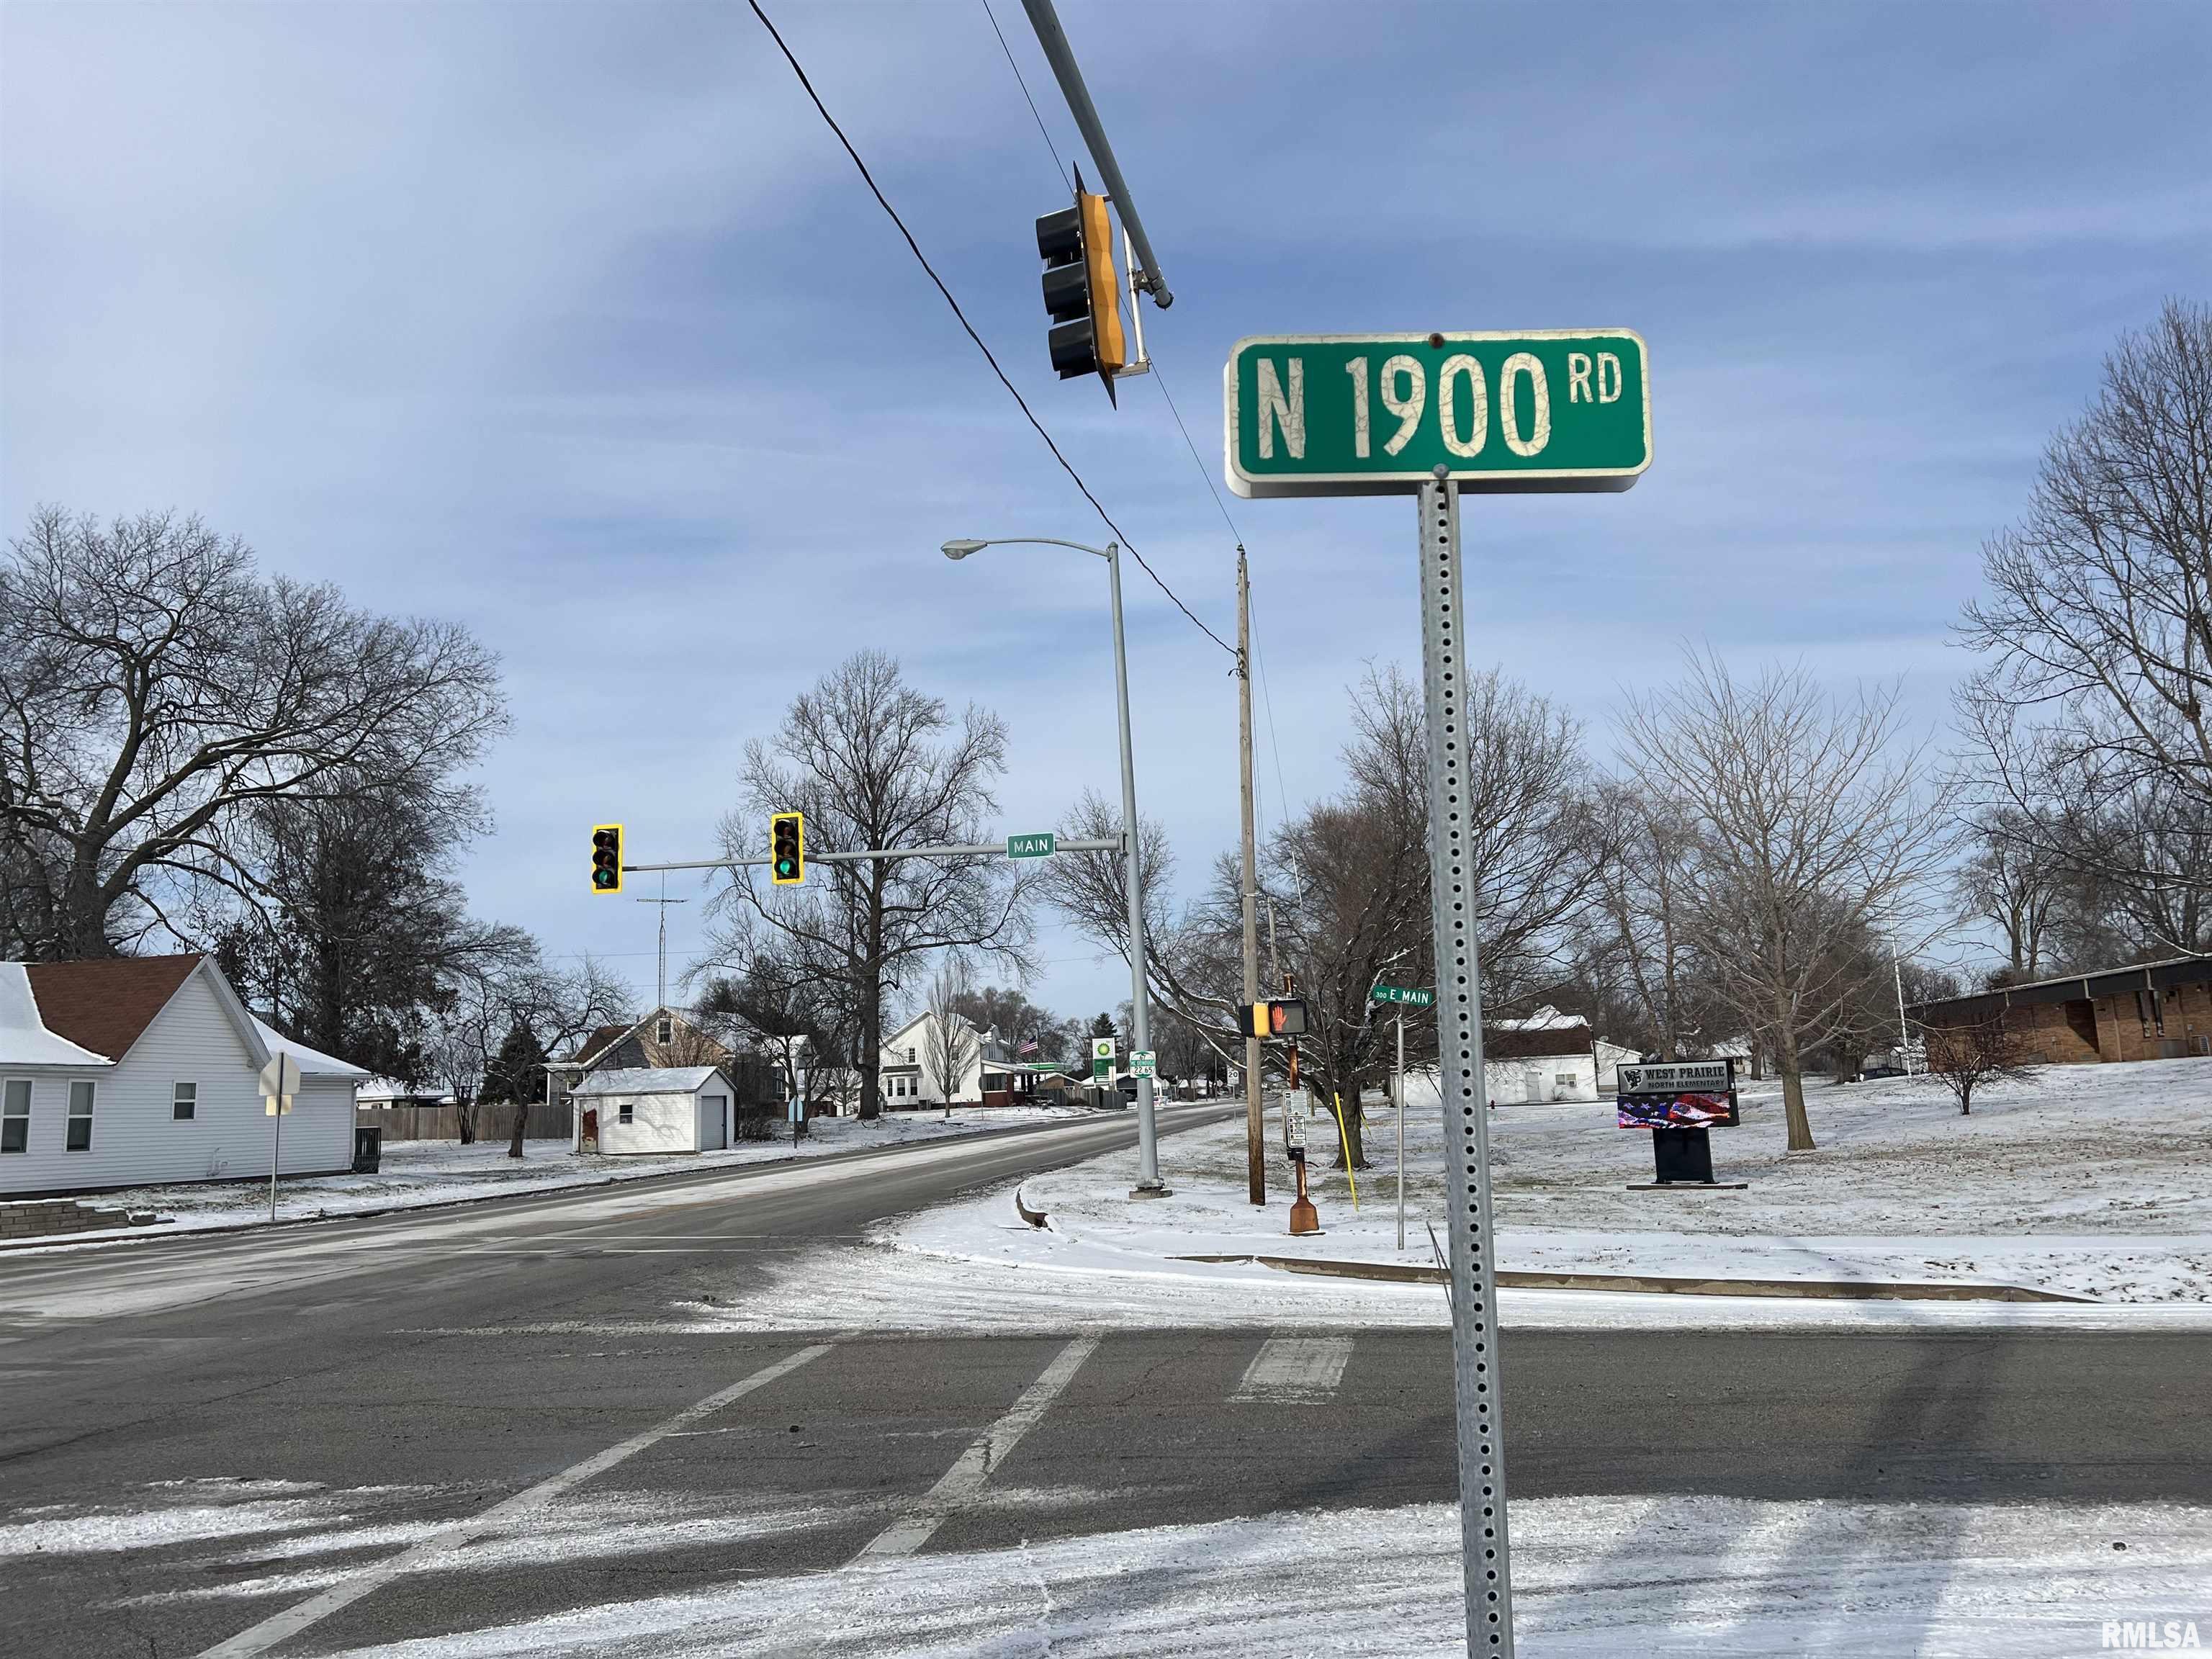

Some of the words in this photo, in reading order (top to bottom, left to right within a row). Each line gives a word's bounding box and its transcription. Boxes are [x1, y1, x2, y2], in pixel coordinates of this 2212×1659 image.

[1256, 356, 1305, 459] N
[1345, 352, 1552, 458] 1900
[1568, 351, 1623, 404] RD
[1014, 839, 1048, 853] MAIN
[1390, 989, 1397, 1000] E
[1402, 990, 1429, 1004] MAIN
[1645, 1069, 1676, 1080] WEST
[1678, 1066, 1725, 1079] PRAIRIE
